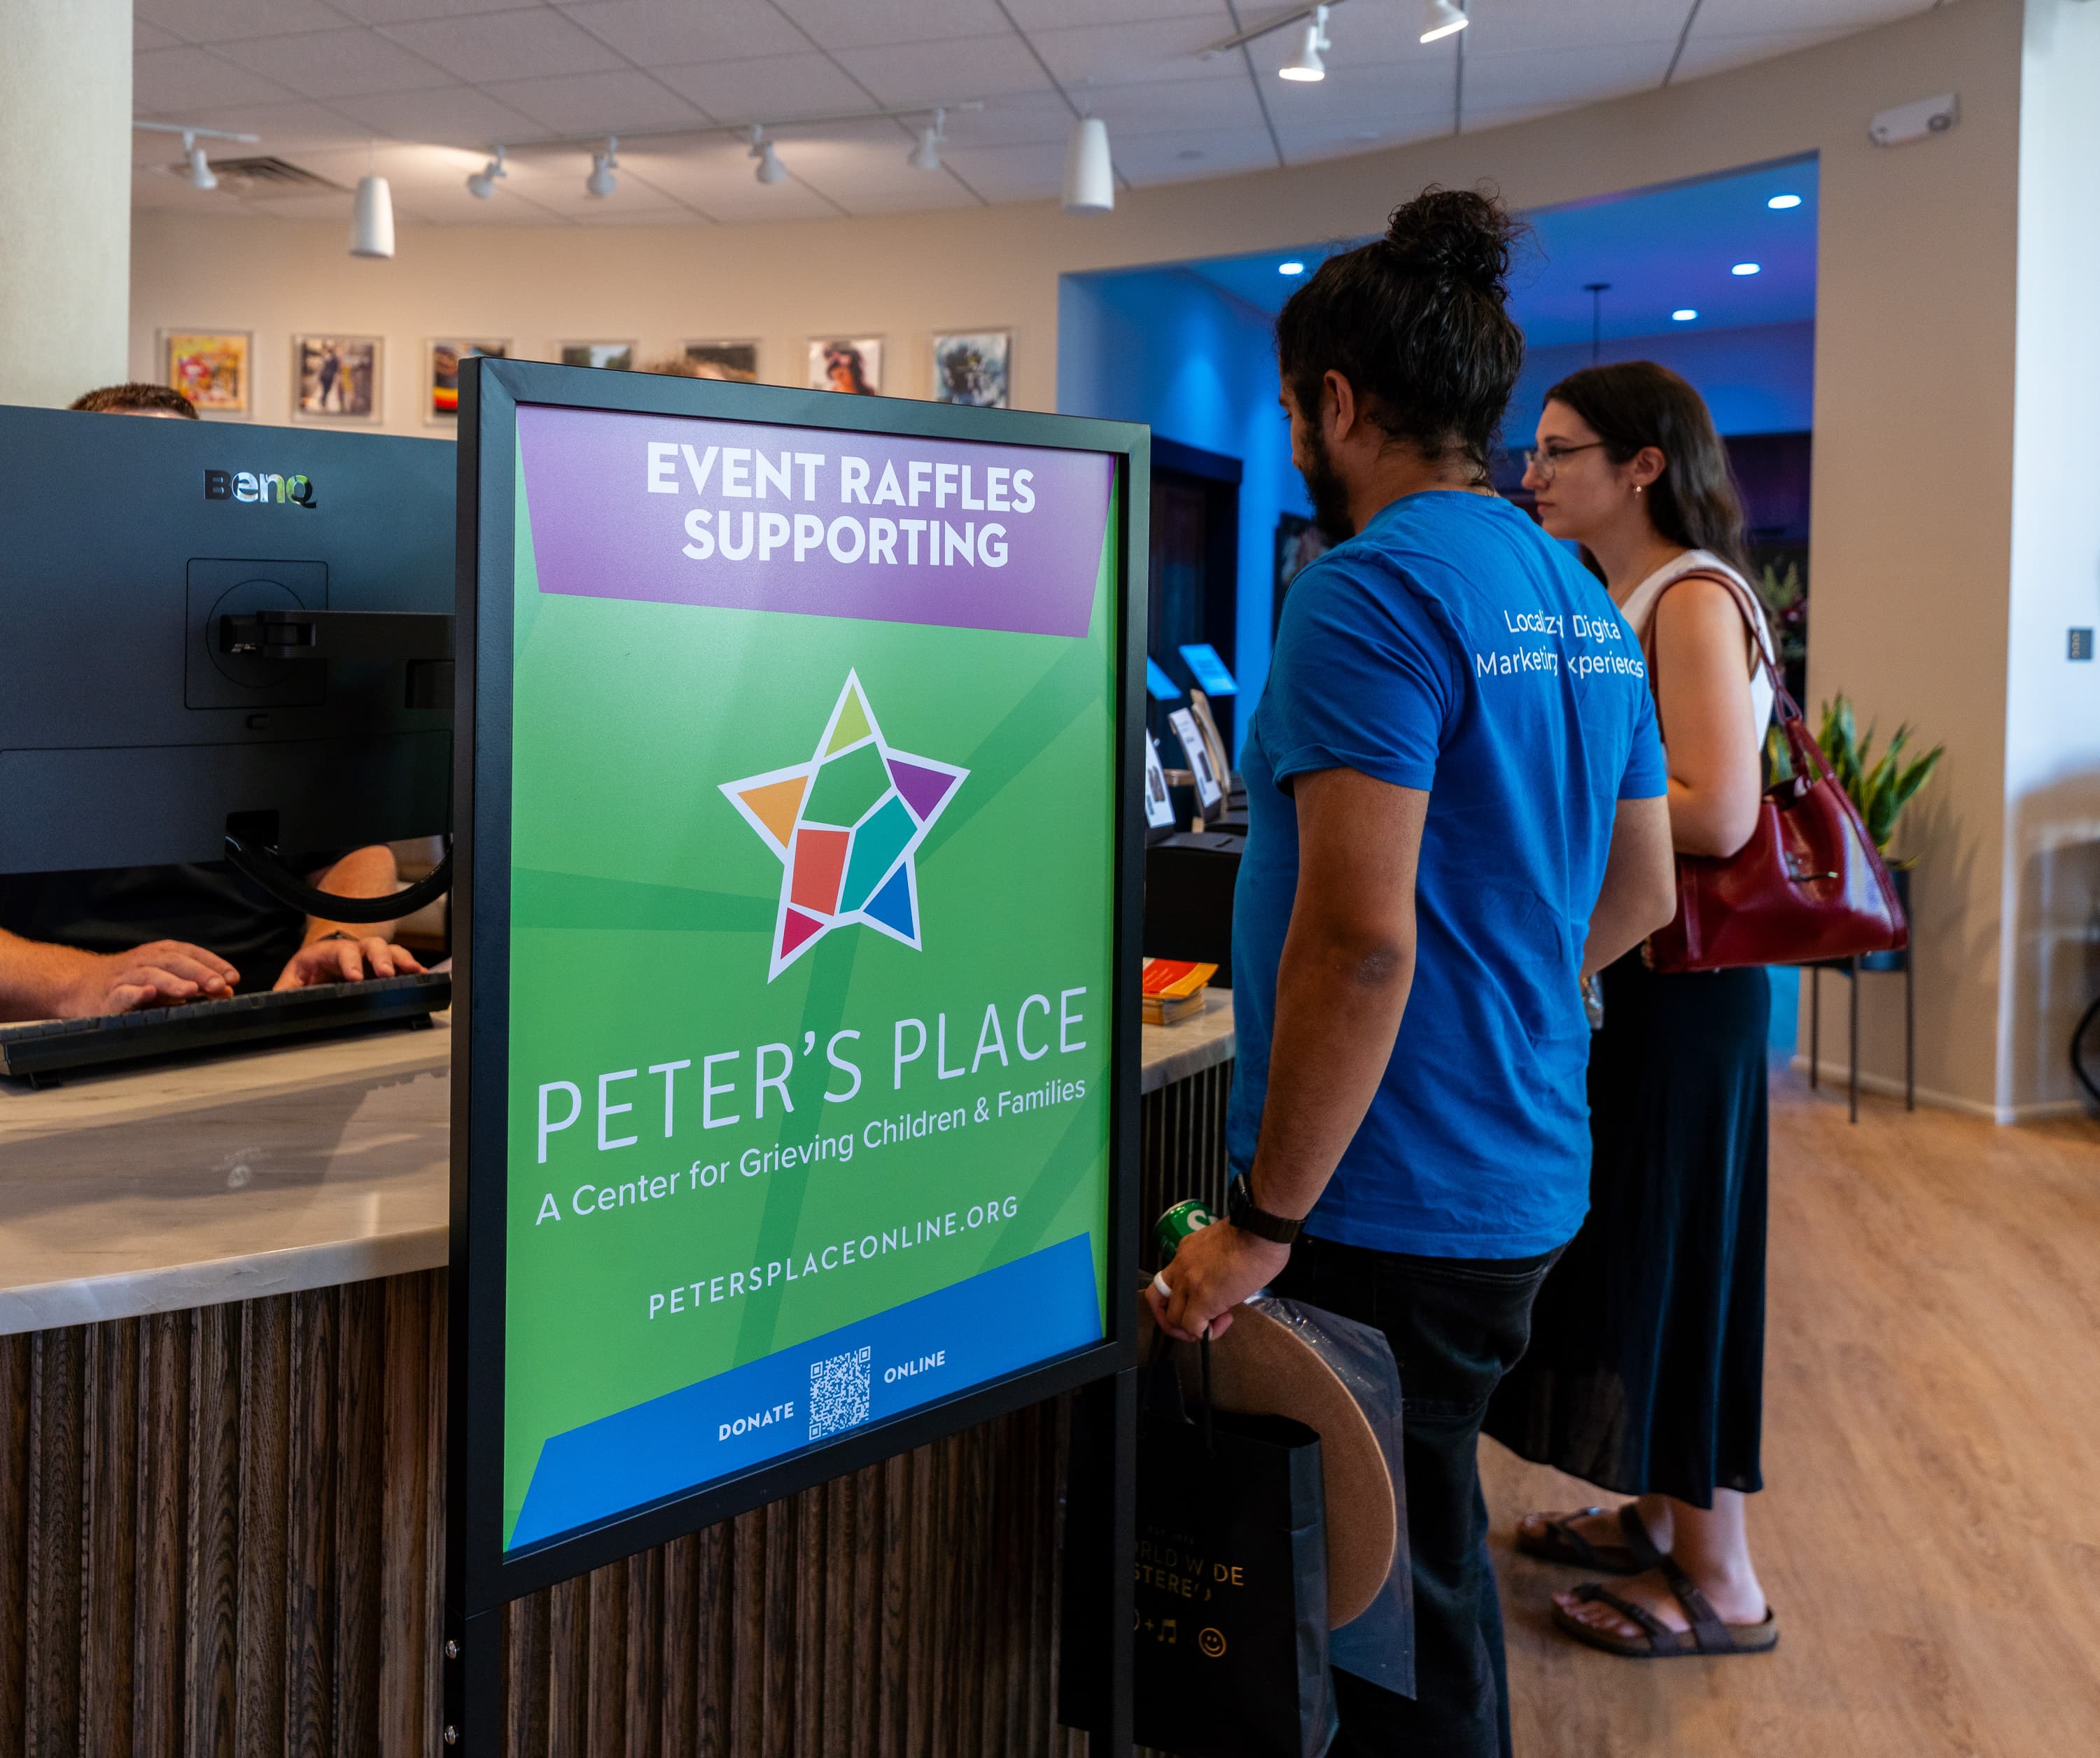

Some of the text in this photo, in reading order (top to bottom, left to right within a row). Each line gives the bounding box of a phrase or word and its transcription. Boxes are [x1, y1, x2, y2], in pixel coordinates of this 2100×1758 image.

[204, 470, 317, 509] BenQ
[647, 442, 1037, 514] EVENT RAFFLES
[680, 508, 1009, 568] SUPPORTING
[1573, 614, 1622, 643] Digita
[538, 986, 1087, 1165] PETER'S PLACE
[535, 1080, 1085, 1225] A Center for Grieving Children & Families
[650, 1196, 1018, 1321] PETERSPLACEONLINE.ORG
[719, 1350, 946, 1441] DONATE ONLINE
[1186, 1557, 1245, 1587] WDE
